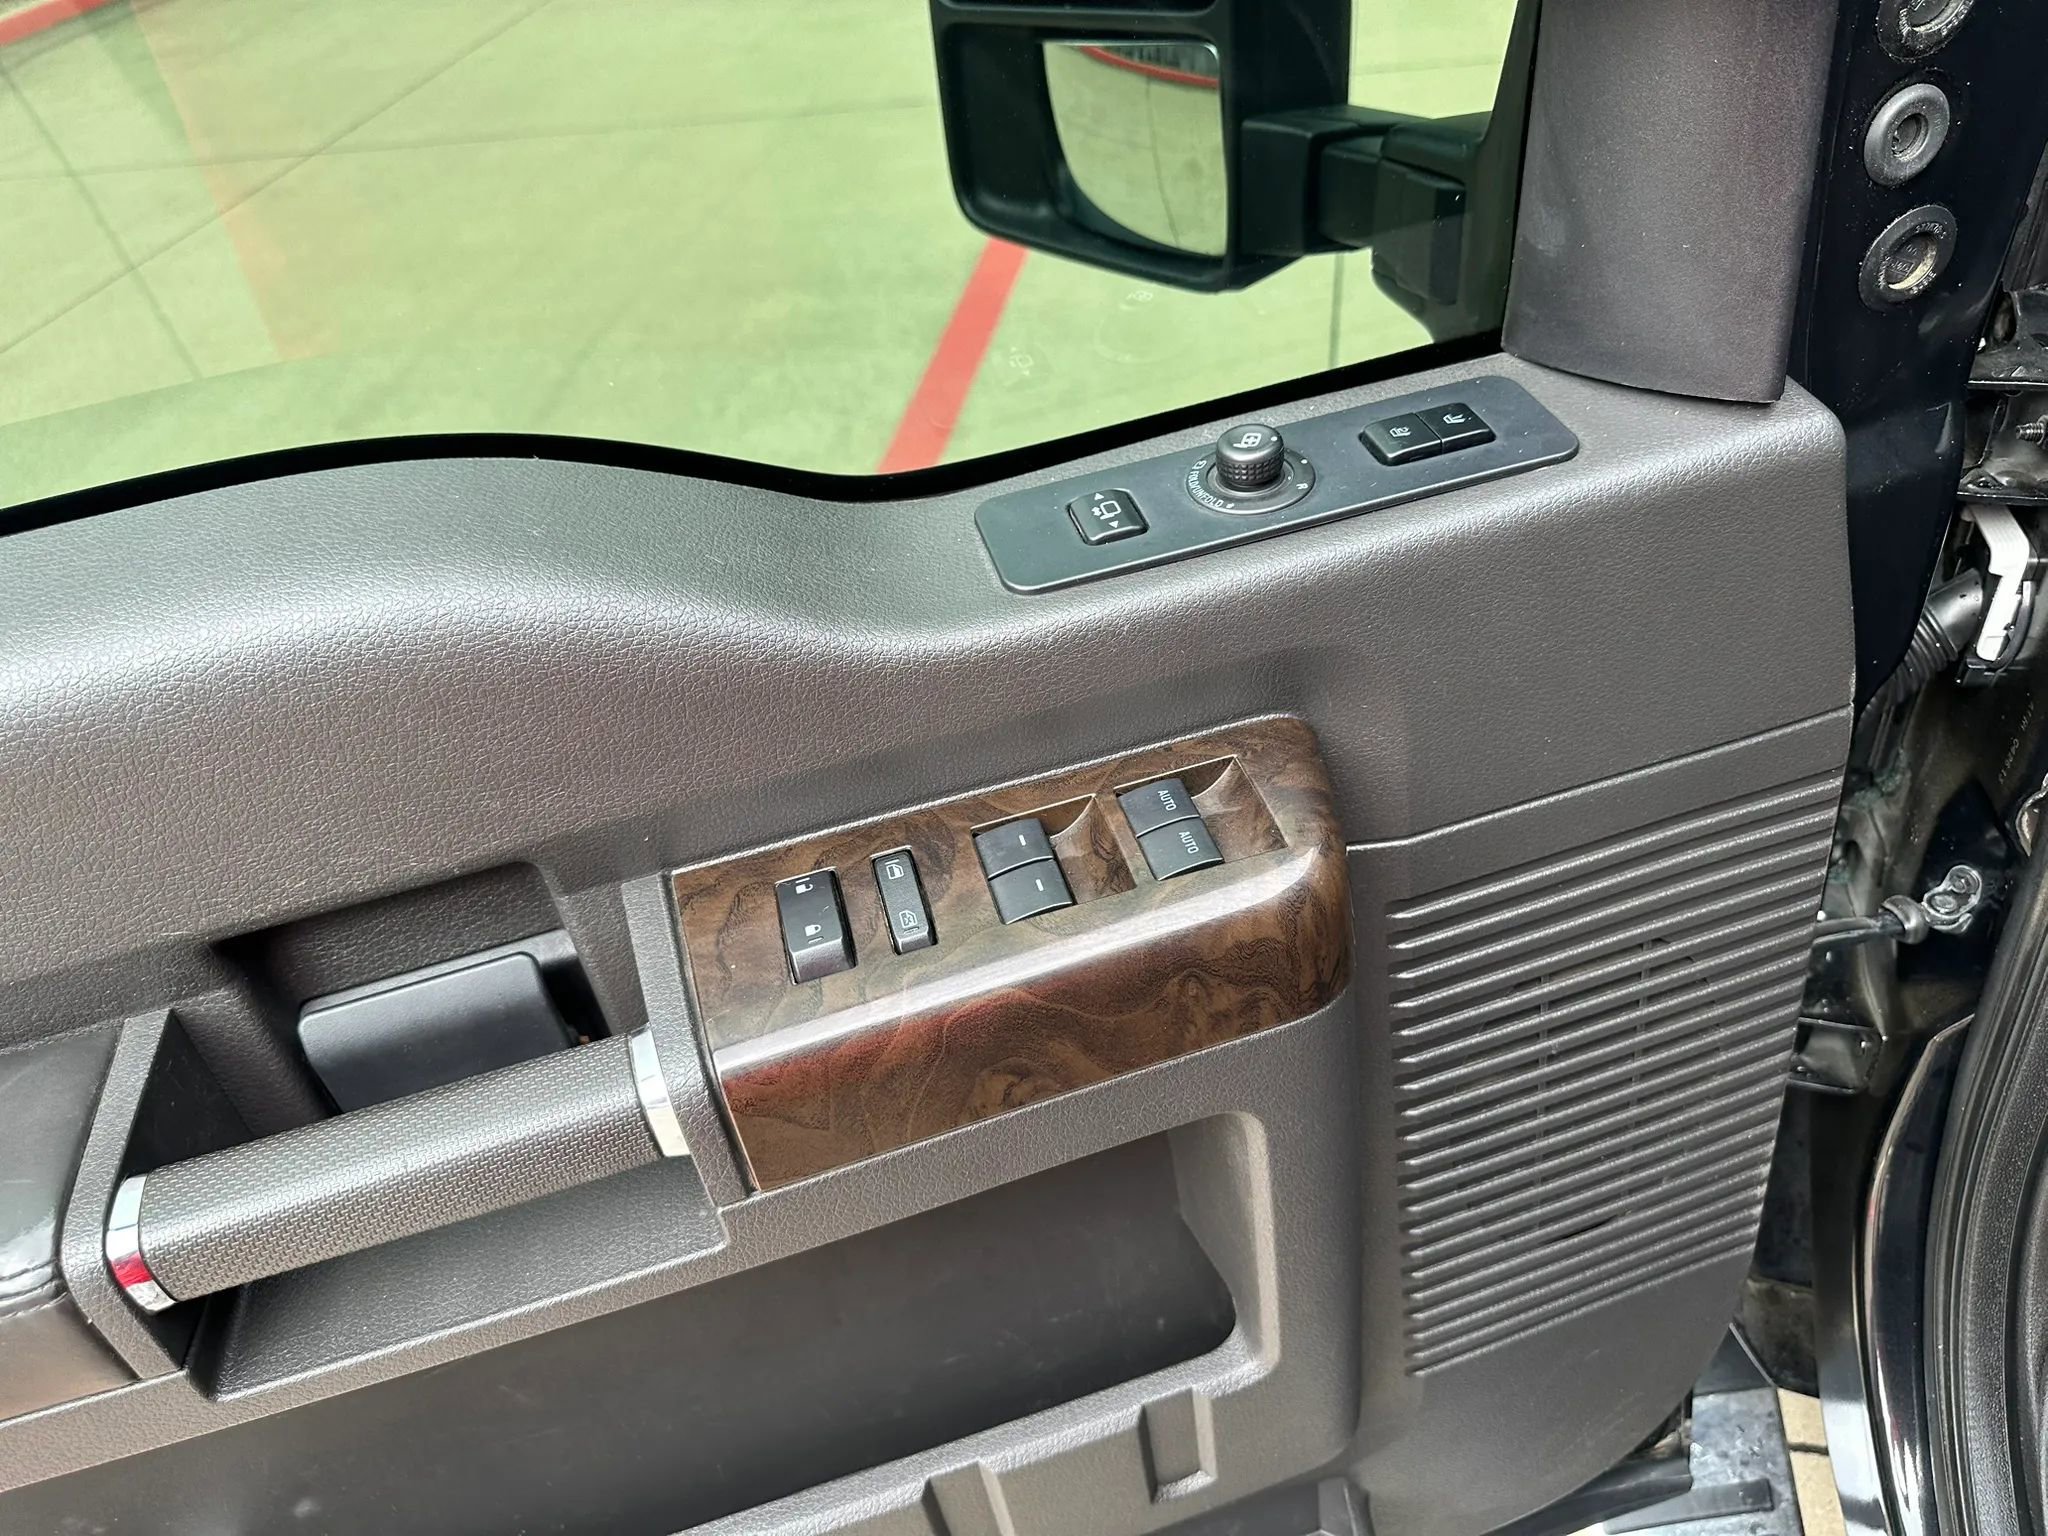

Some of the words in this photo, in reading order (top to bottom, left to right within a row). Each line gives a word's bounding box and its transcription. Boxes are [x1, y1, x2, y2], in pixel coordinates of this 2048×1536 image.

[1188, 470, 1224, 507] FOLD/UNFOLD
[1157, 790, 1177, 811] AUTO
[1178, 831, 1199, 854] AUTO
